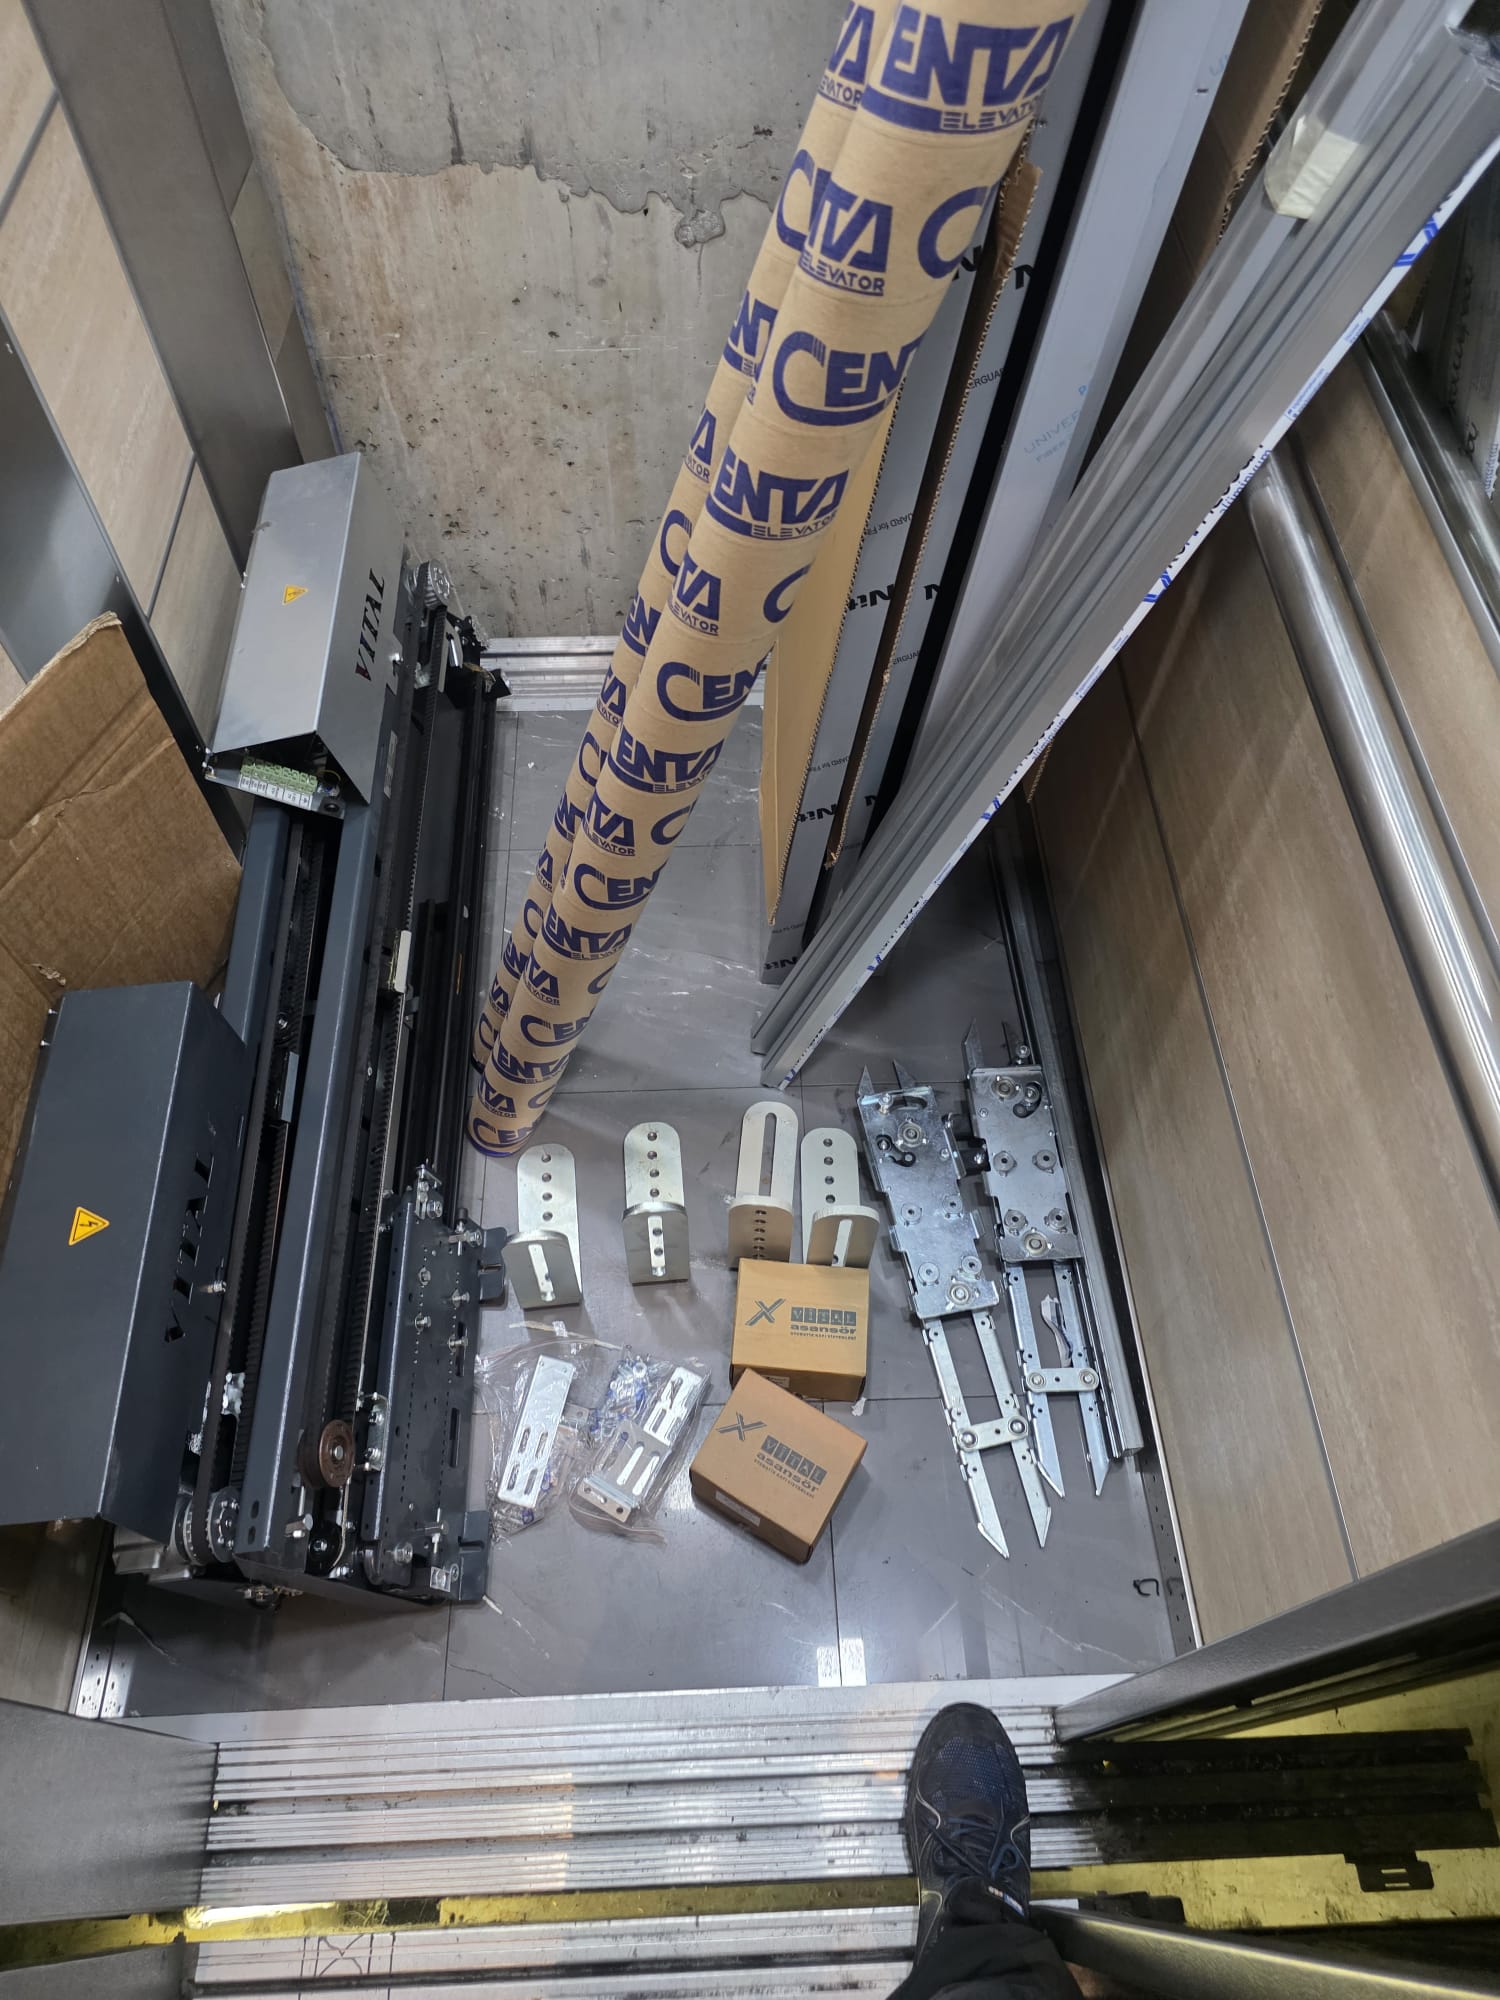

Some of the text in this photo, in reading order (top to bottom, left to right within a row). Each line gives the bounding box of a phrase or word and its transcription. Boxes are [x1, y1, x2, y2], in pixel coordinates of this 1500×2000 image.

[876, 5, 1074, 108] ENTA
[712, 445, 849, 526] ENTA
[355, 568, 385, 682] VITAL
[614, 727, 725, 785] ENTA
[543, 903, 632, 954] ENTA
[164, 1151, 215, 1344] VITAL
